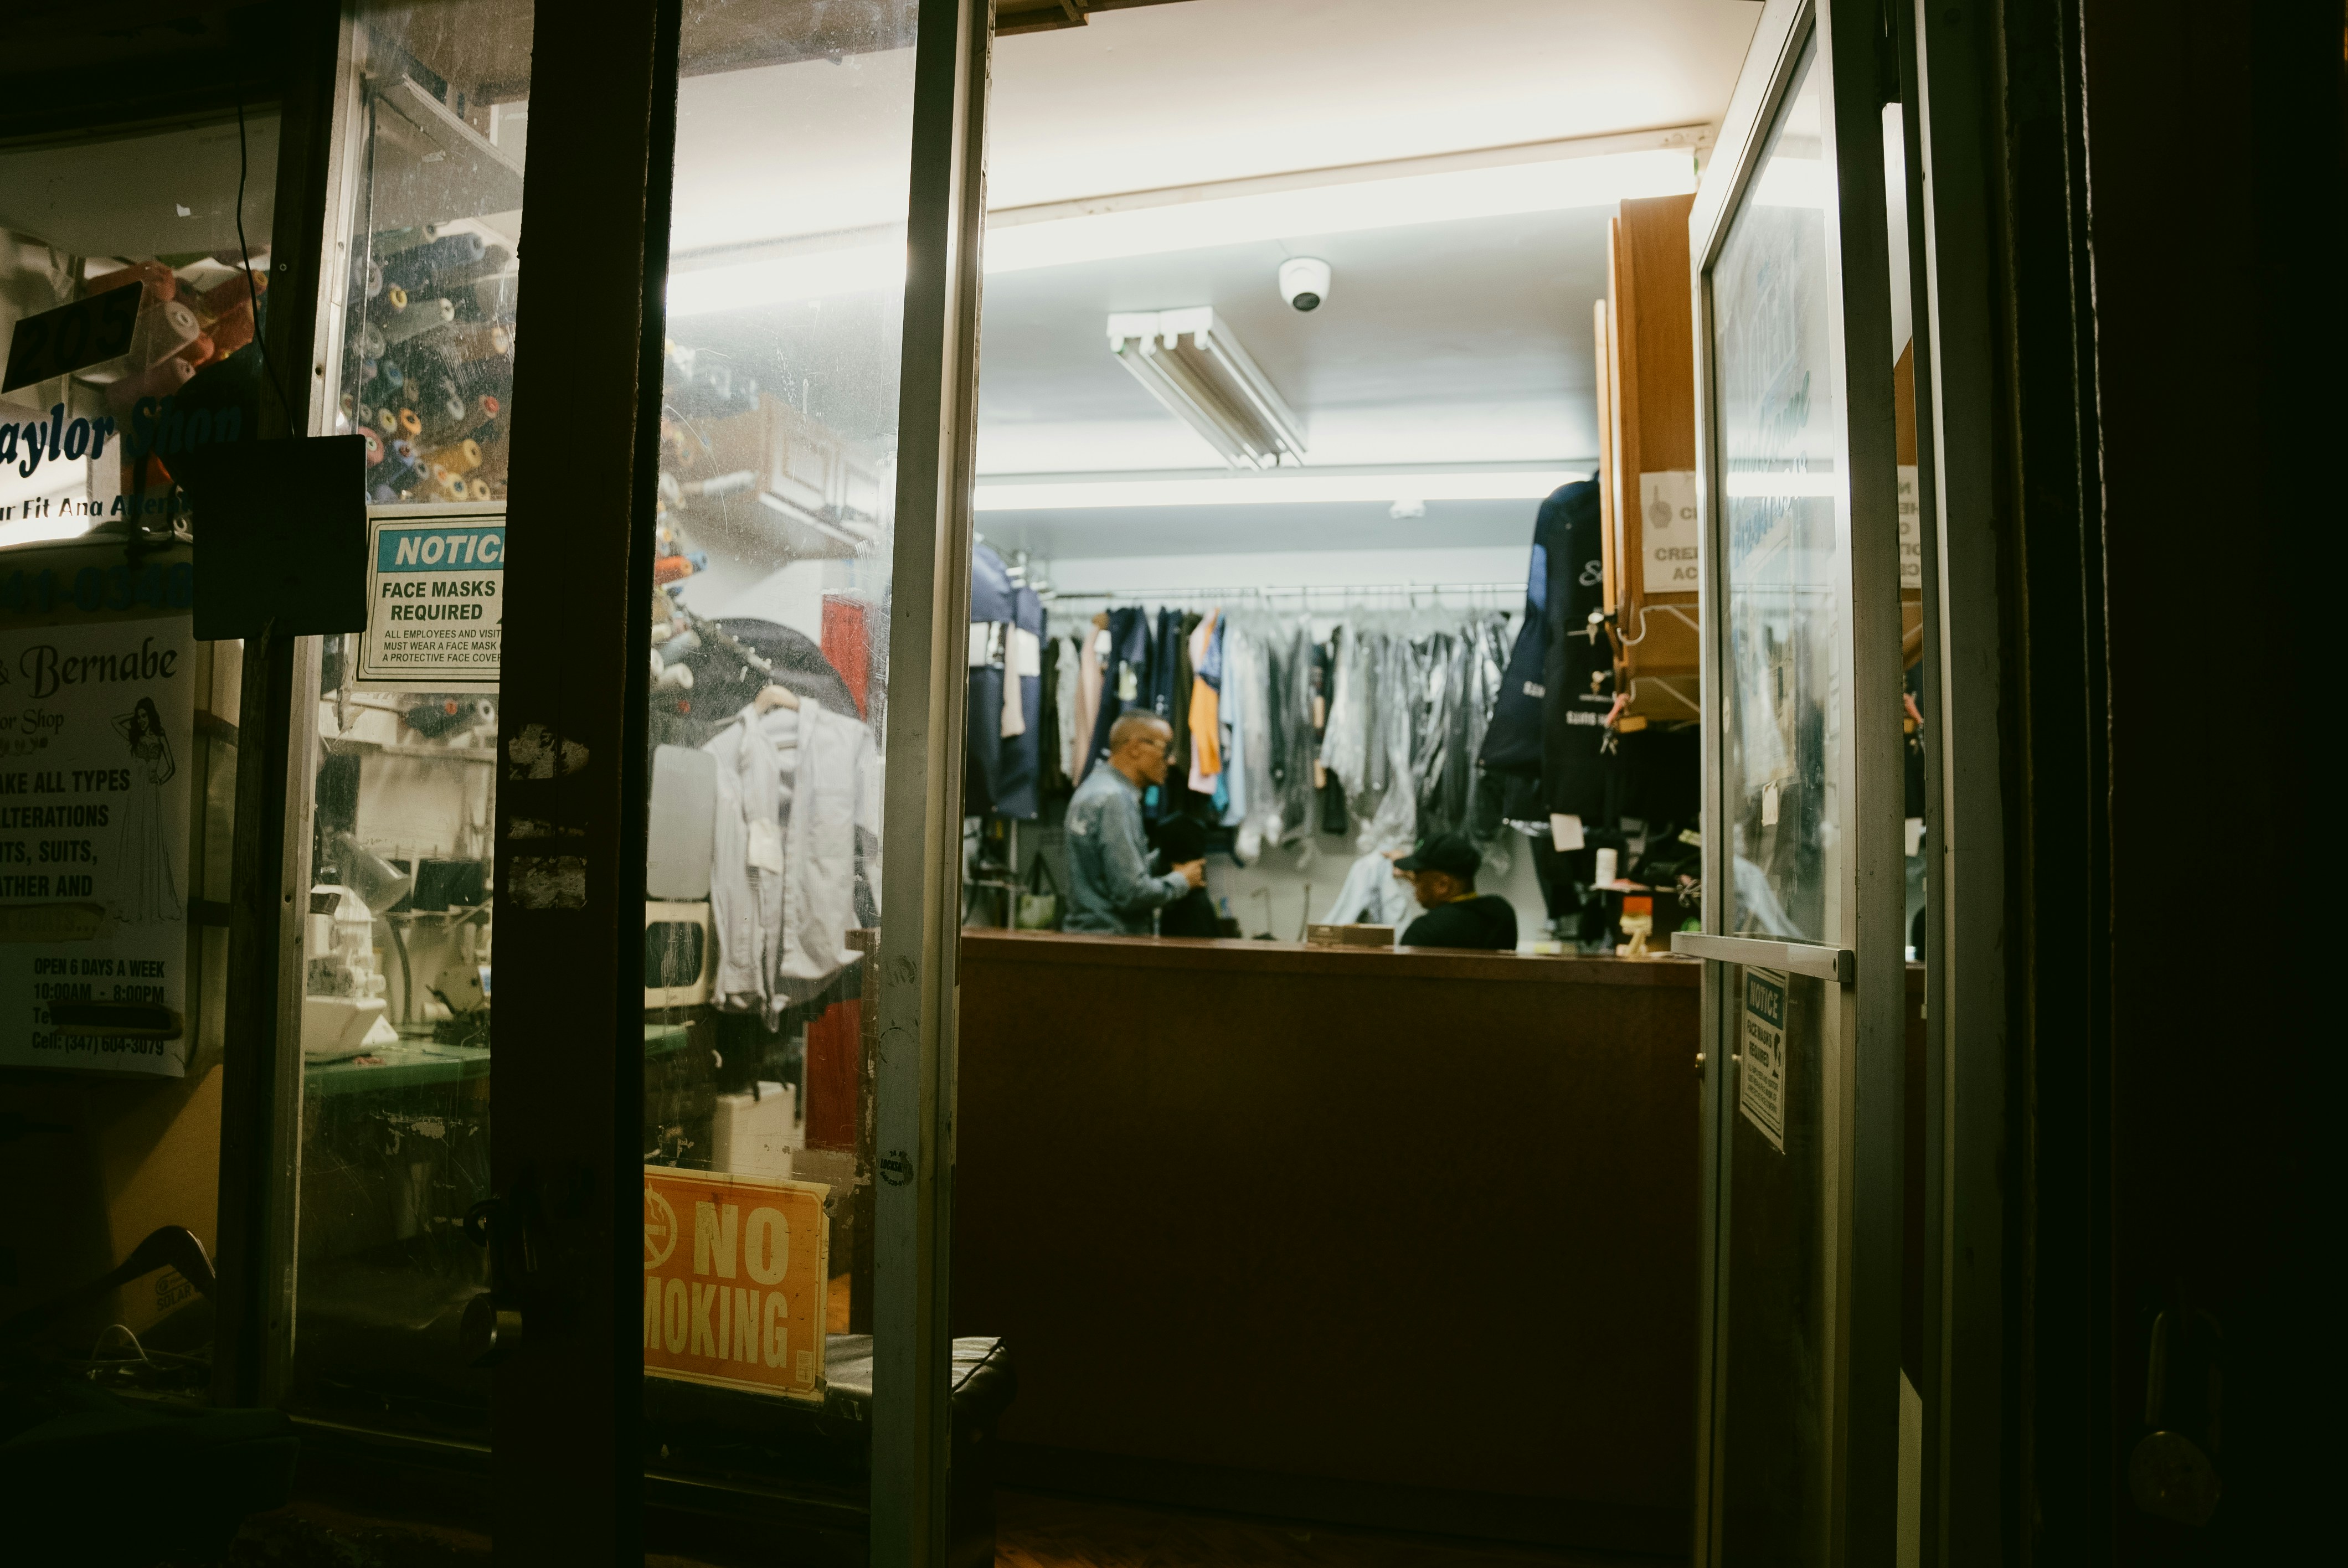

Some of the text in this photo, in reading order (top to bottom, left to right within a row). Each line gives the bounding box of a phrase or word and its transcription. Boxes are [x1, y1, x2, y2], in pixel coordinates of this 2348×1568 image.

[11, 286, 136, 384] 205
[23, 497, 50, 519] Fit
[382, 580, 496, 598] FACE MASKS
[390, 604, 483, 621] REQUIRED
[384, 630, 401, 638] ALL
[403, 630, 456, 638] EMPLOYEES
[458, 630, 476, 638] AND
[384, 641, 497, 650] MUST WEAR A FACE MASK
[19, 637, 178, 699] Bernabe
[382, 653, 388, 662] A
[390, 653, 445, 662] PROTECTIVE
[447, 653, 470, 662] FACE
[21, 708, 64, 735] Shop
[34, 771, 65, 793] ALL
[72, 768, 130, 792] TYPES
[1, 804, 109, 828] LTERATIONS
[38, 840, 97, 866] SUITS,
[55, 875, 92, 897] AND
[34, 957, 165, 978] OPEN 6 DAYS A WEEK
[33, 982, 91, 1000] 10:00AM
[113, 984, 164, 1004] 8:00PM
[1750, 980, 1779, 1020] NOTICE
[33, 1007, 50, 1024] Te
[693, 1200, 790, 1286] NO
